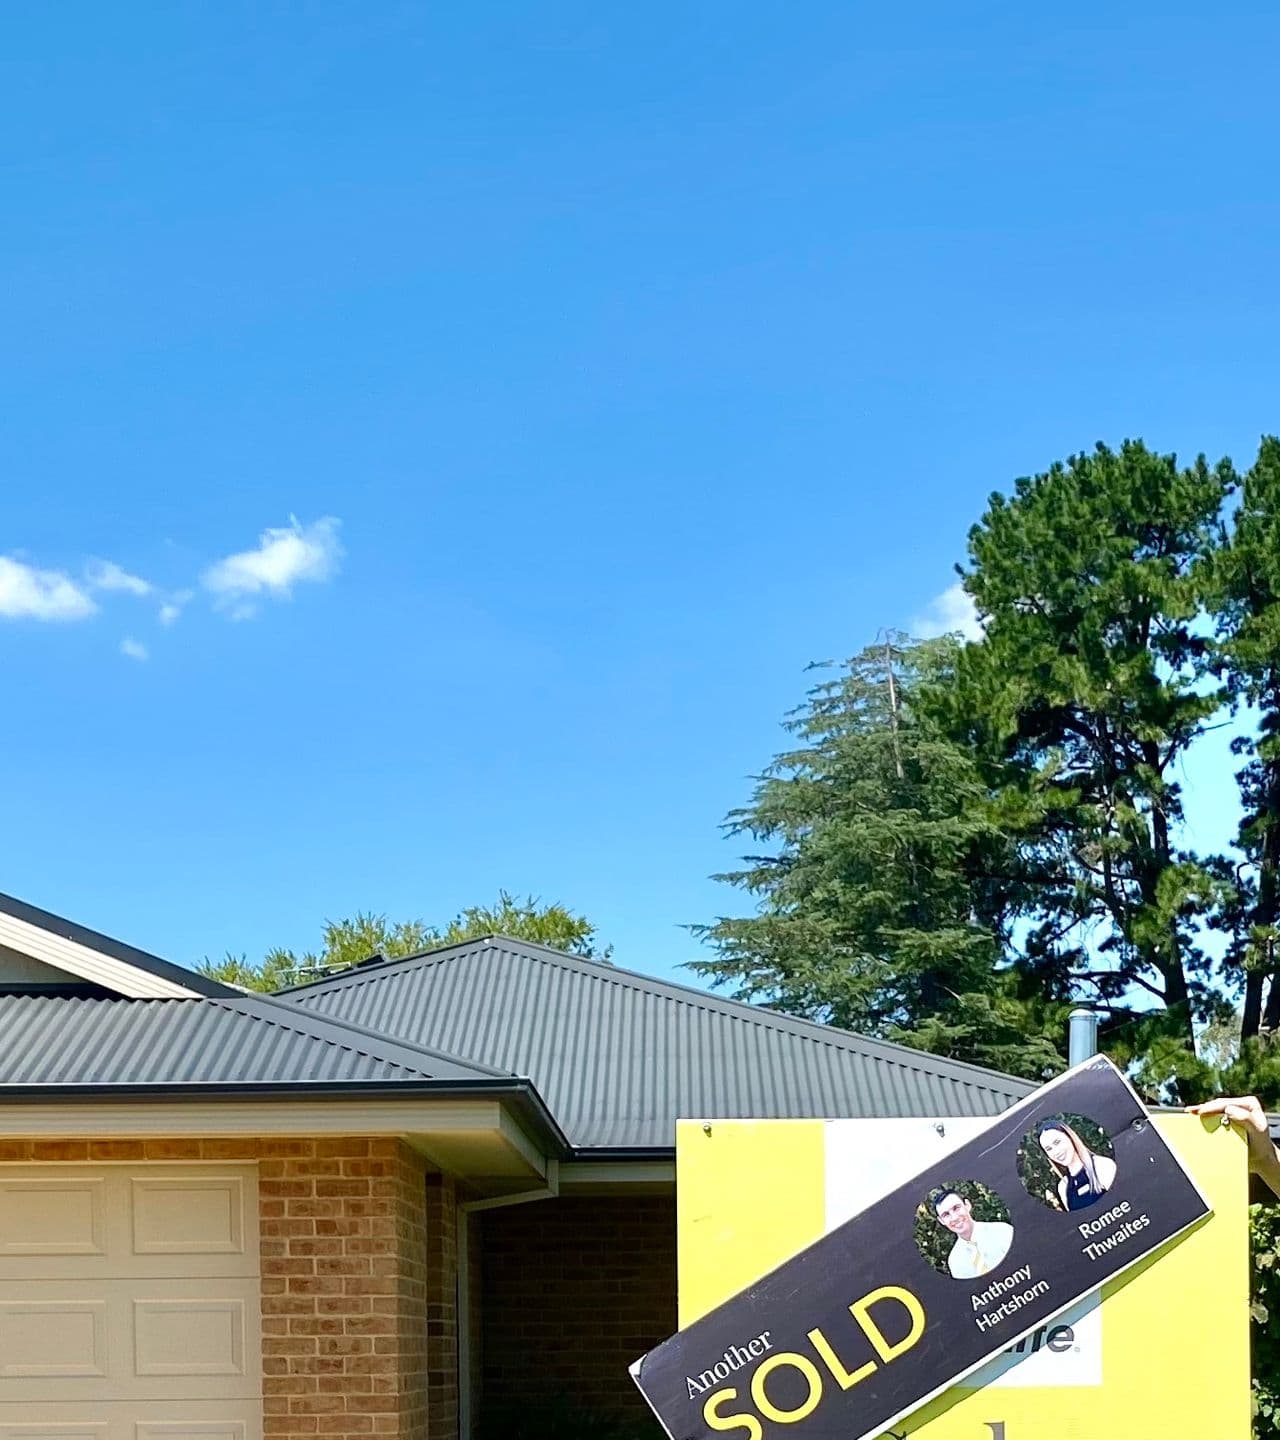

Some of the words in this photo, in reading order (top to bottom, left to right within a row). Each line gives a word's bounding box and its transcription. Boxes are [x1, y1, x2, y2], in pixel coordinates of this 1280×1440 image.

[1078, 1199, 1132, 1240] Romee
[1082, 1212, 1150, 1262] Thwaites
[971, 1264, 1033, 1311] Anthony
[975, 1279, 1050, 1332] Hartshorn
[685, 1329, 774, 1399] Another
